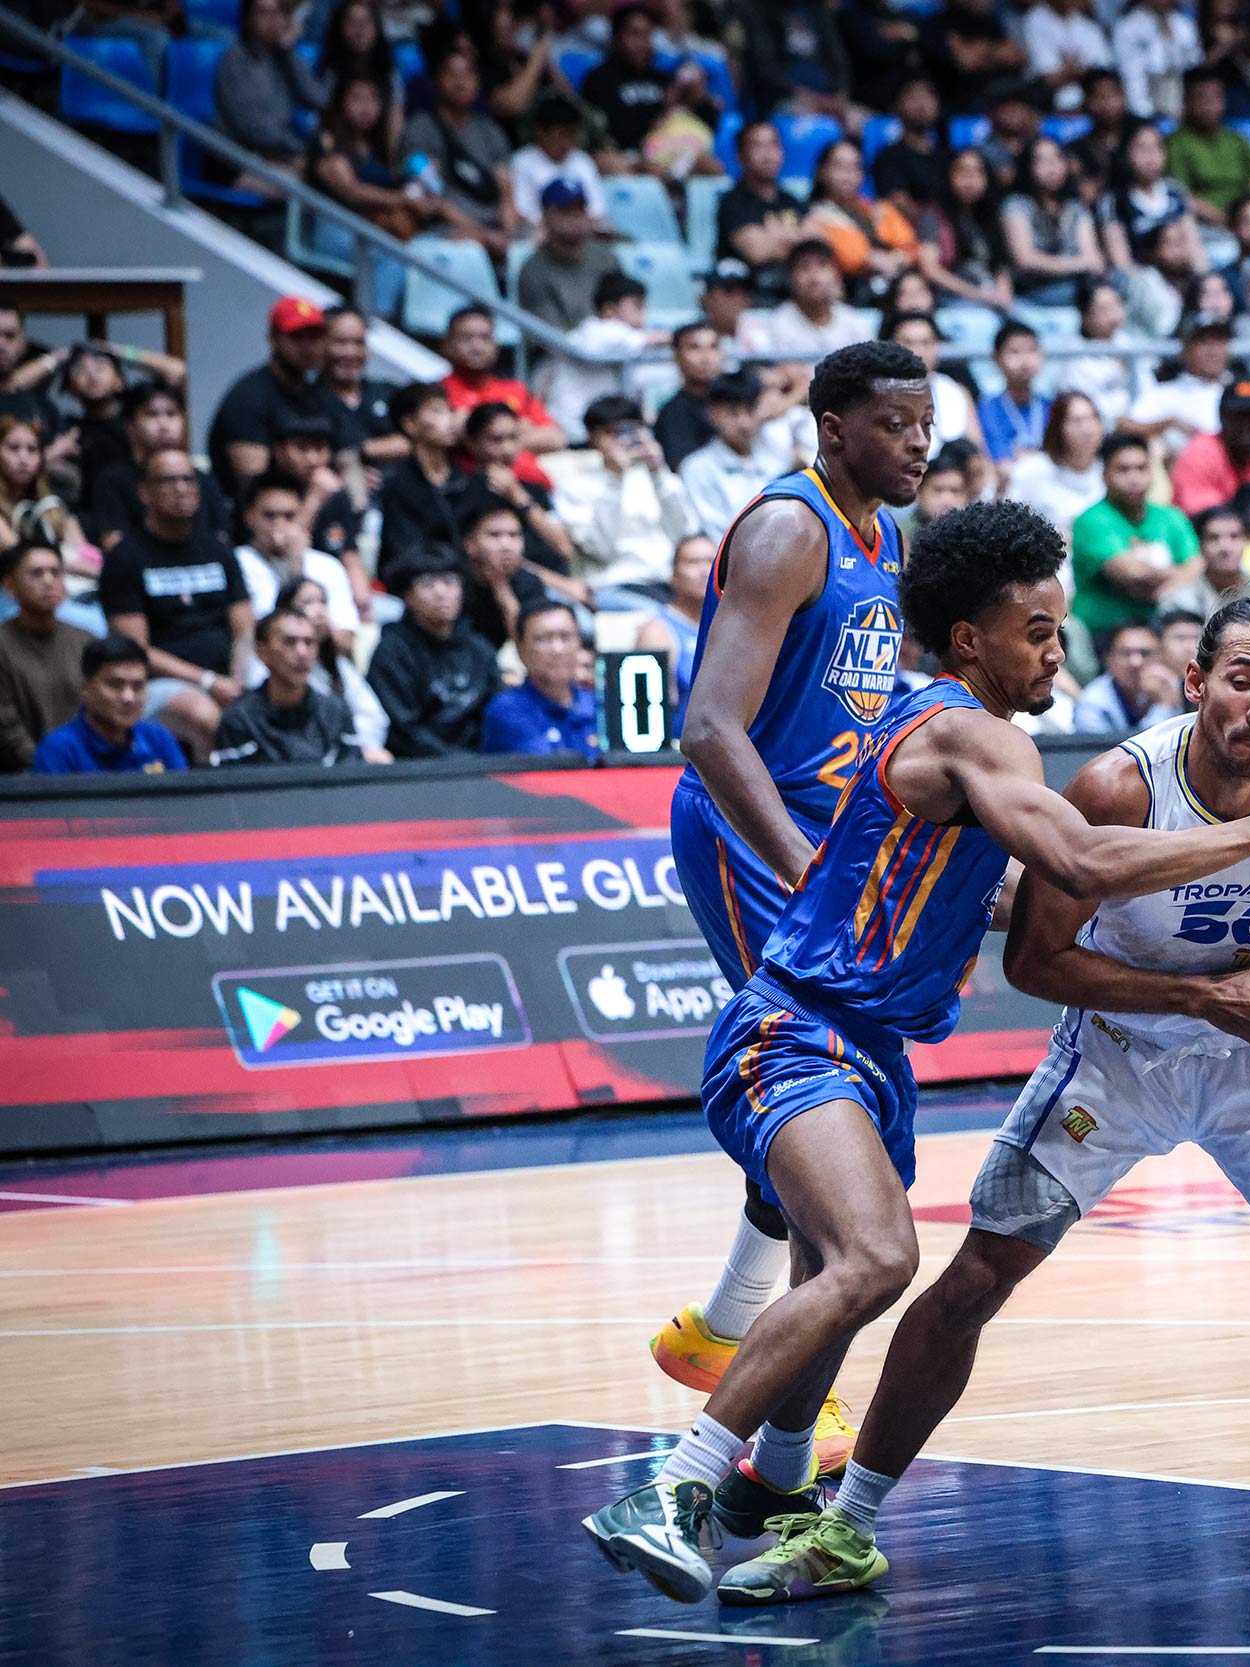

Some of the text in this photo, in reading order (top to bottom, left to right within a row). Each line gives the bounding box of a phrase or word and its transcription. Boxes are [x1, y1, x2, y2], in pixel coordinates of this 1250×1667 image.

[828, 669, 861, 688] ROAD
[619, 655, 665, 753] 0
[101, 881, 254, 941] NOW
[275, 861, 578, 932] AVAILABLE
[315, 996, 504, 1046] Google Play
[646, 982, 713, 1023] App
[1060, 1107, 1100, 1138] TNT
